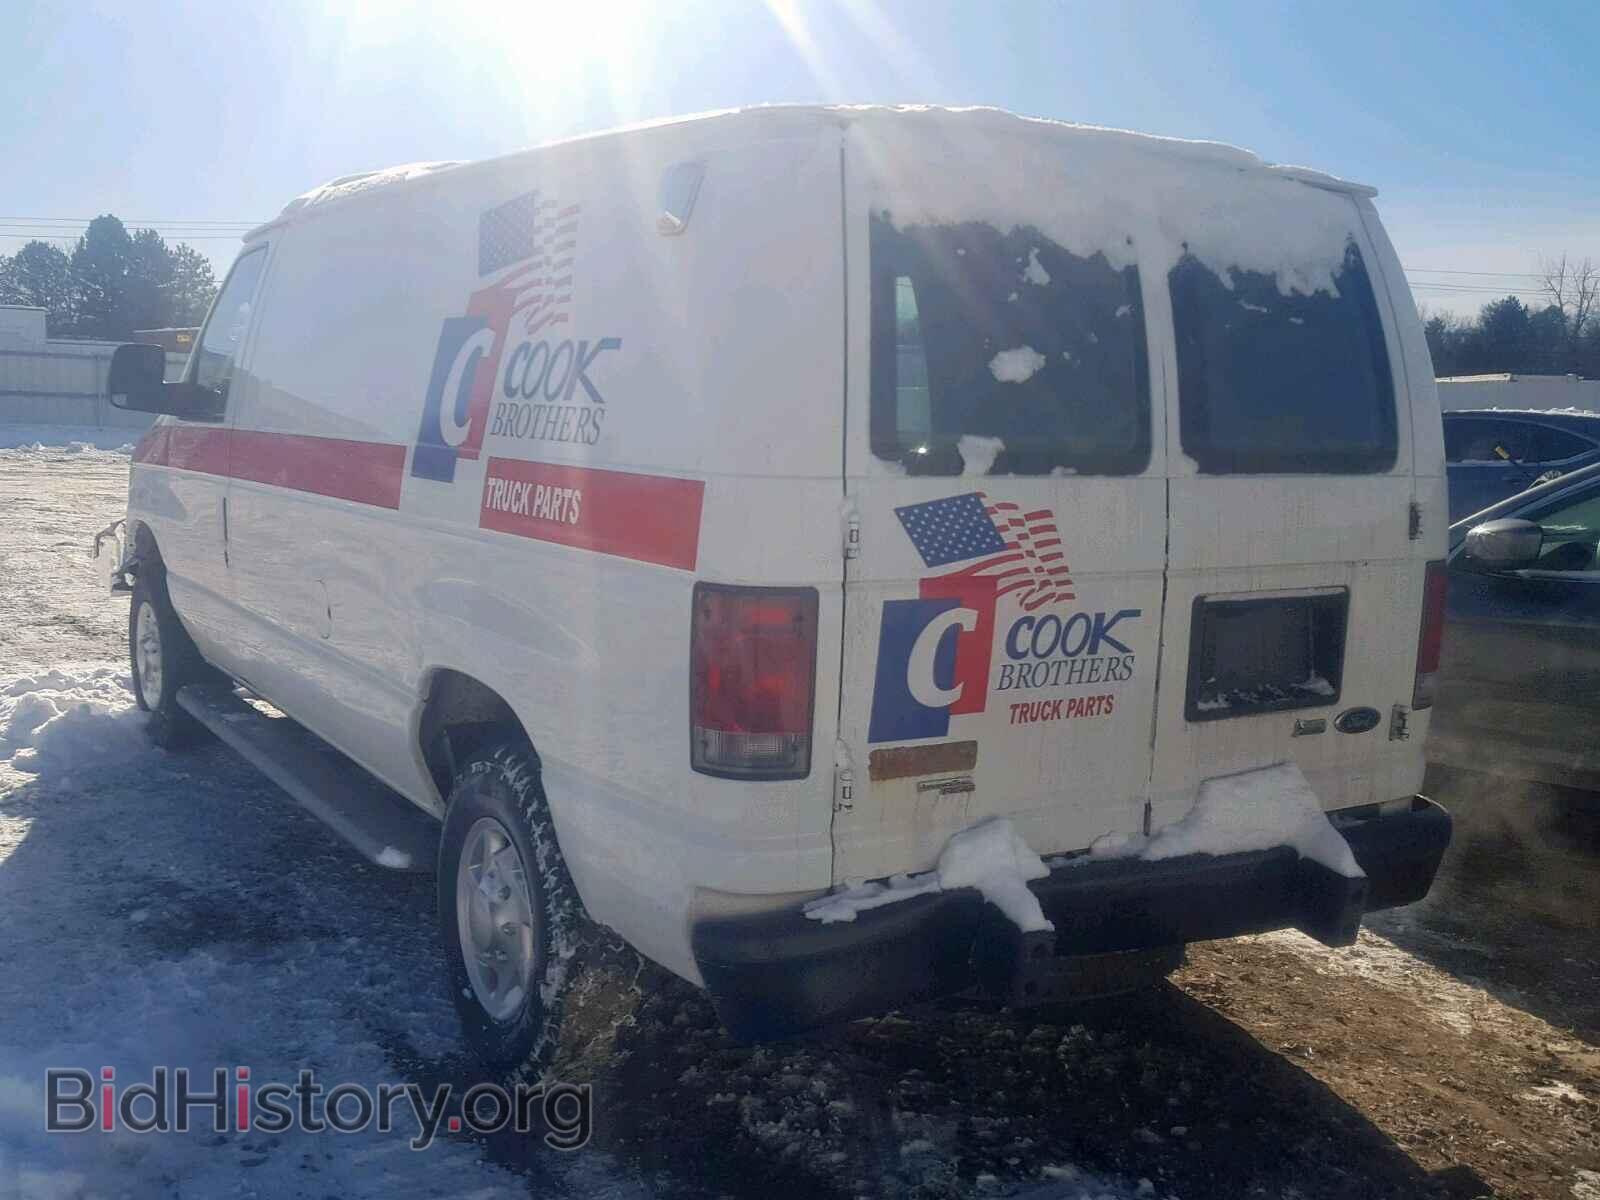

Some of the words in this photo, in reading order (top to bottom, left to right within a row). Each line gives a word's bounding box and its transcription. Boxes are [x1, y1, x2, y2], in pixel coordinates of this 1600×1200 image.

[505, 337, 622, 404] COOK
[490, 401, 606, 446] BROTHERS
[486, 477, 533, 516] TRUCK
[532, 484, 582, 525] PARTS
[1005, 609, 1142, 660] COOK
[994, 655, 1135, 690] BROTHERS
[1009, 700, 1062, 725] TRUCK
[1065, 694, 1114, 719] PARTS
